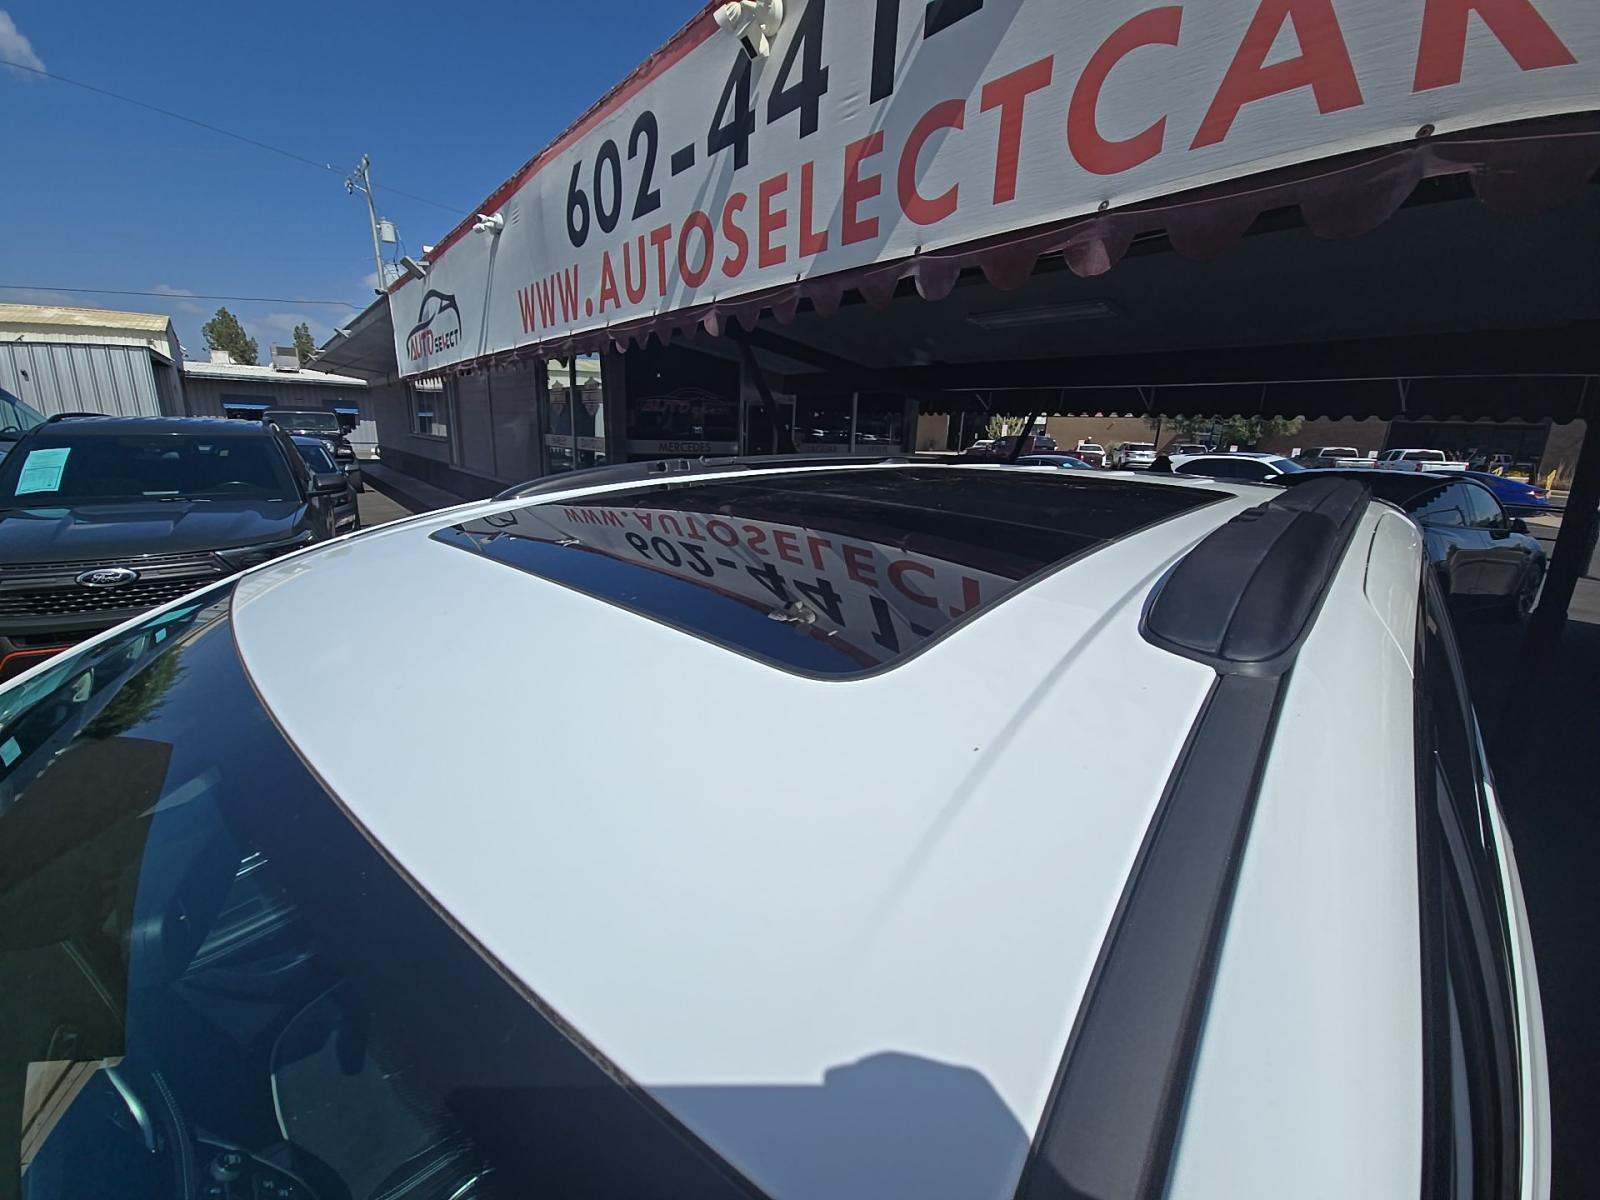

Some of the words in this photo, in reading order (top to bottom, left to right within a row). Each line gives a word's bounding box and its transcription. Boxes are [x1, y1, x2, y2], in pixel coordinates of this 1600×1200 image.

[410, 329, 434, 361] AUTO
[434, 329, 459, 353] SELECT
[658, 441, 712, 453] MERCEDES
[91, 572, 123, 583] Ford
